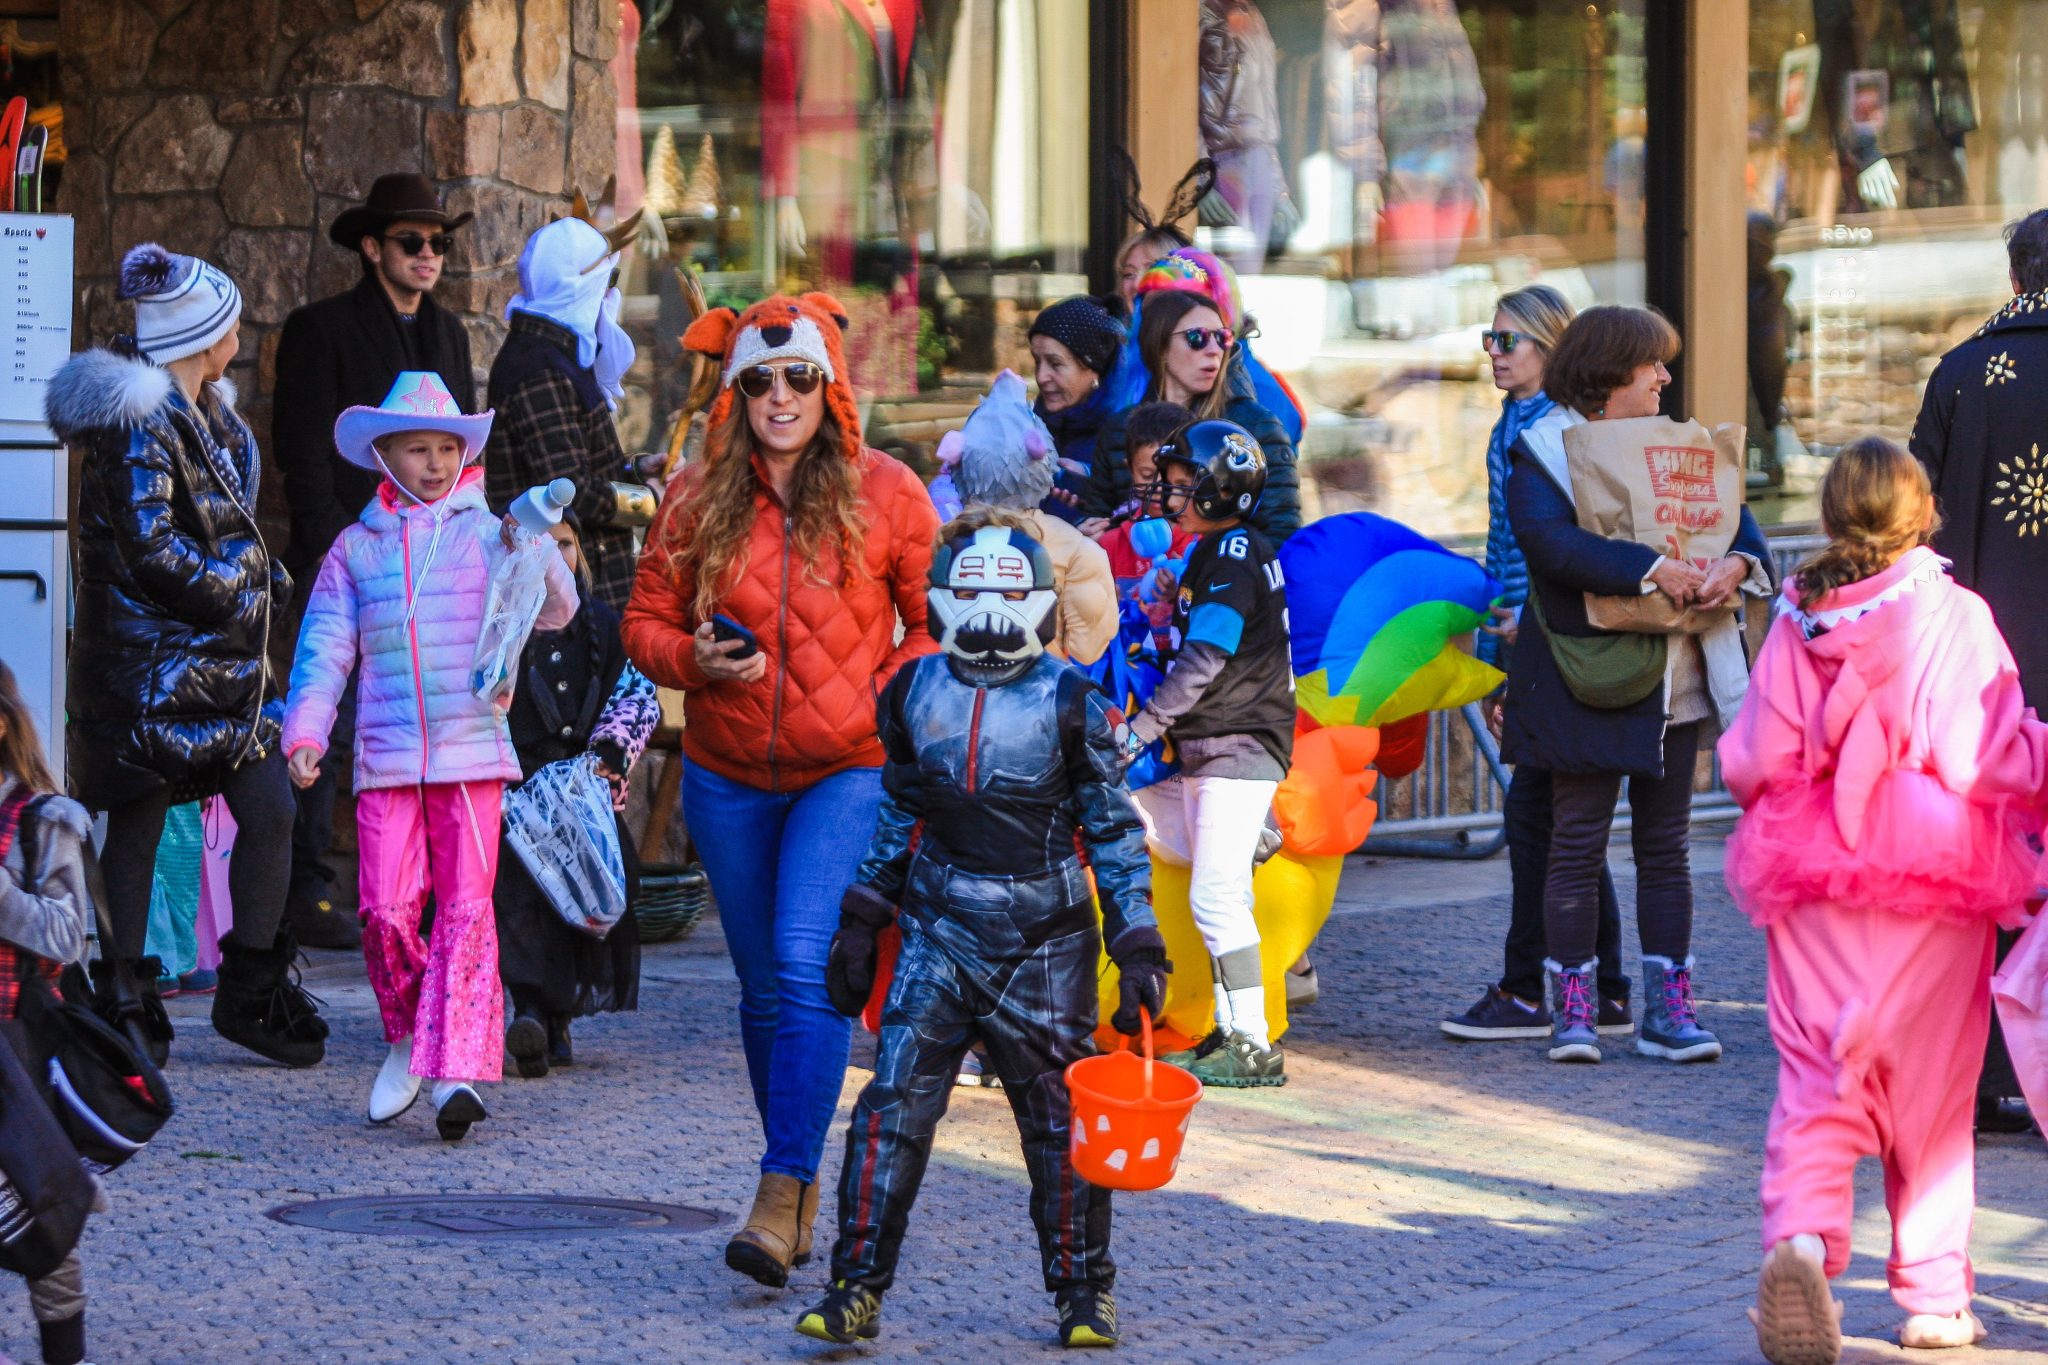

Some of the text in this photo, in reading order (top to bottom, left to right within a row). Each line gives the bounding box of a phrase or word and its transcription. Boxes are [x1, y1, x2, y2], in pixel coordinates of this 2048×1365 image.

[4, 227, 32, 237] Sports
[1652, 449, 1709, 477] KING
[1218, 535, 1249, 560] 16
